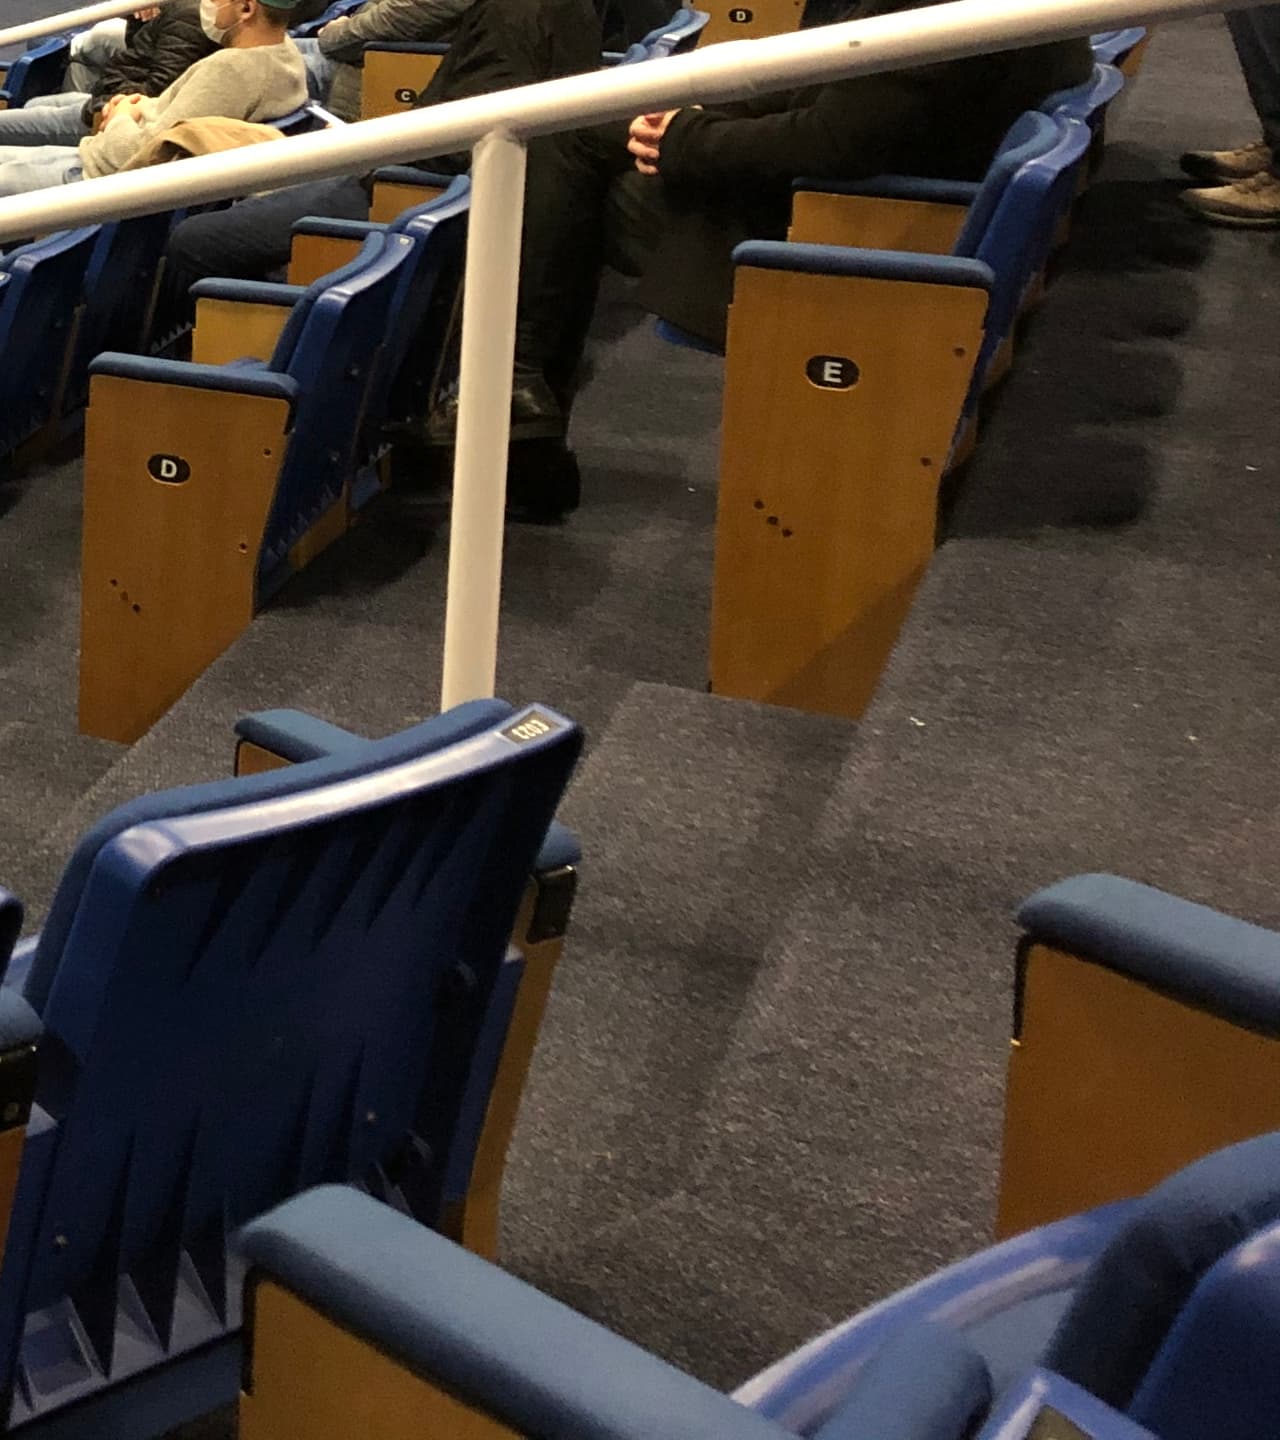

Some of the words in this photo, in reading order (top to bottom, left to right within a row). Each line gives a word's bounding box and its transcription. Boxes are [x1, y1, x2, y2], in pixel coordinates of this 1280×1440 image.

[736, 10, 746, 21] D
[400, 90, 410, 101] C
[824, 361, 842, 382] E
[160, 459, 179, 478] D
